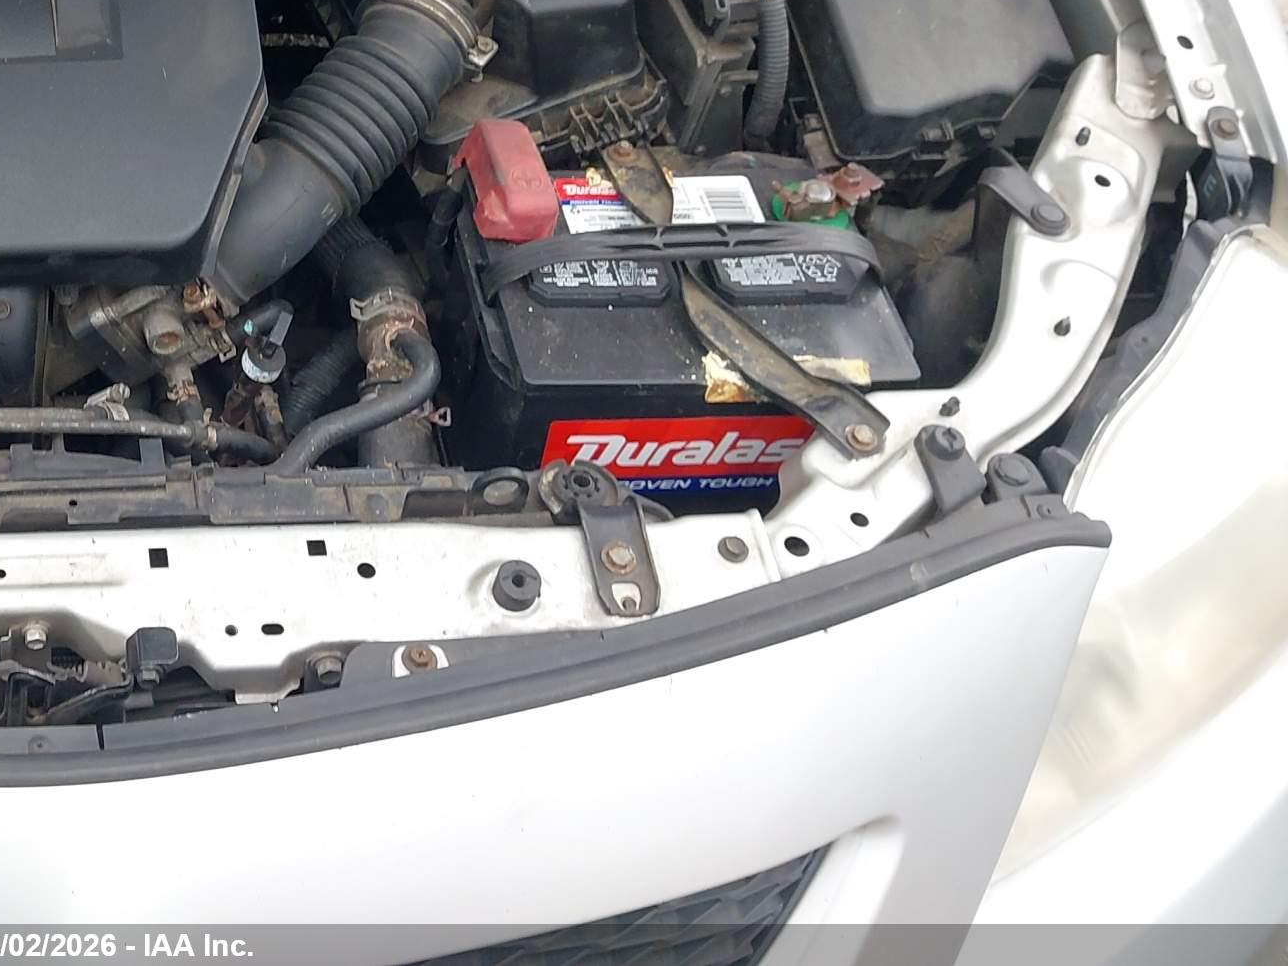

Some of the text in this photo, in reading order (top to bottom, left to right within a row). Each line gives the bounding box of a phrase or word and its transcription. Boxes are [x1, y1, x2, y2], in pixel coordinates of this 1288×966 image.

[562, 183, 617, 196] Duralas
[566, 431, 805, 468] Duralas
[698, 477, 774, 489] TOUGH
